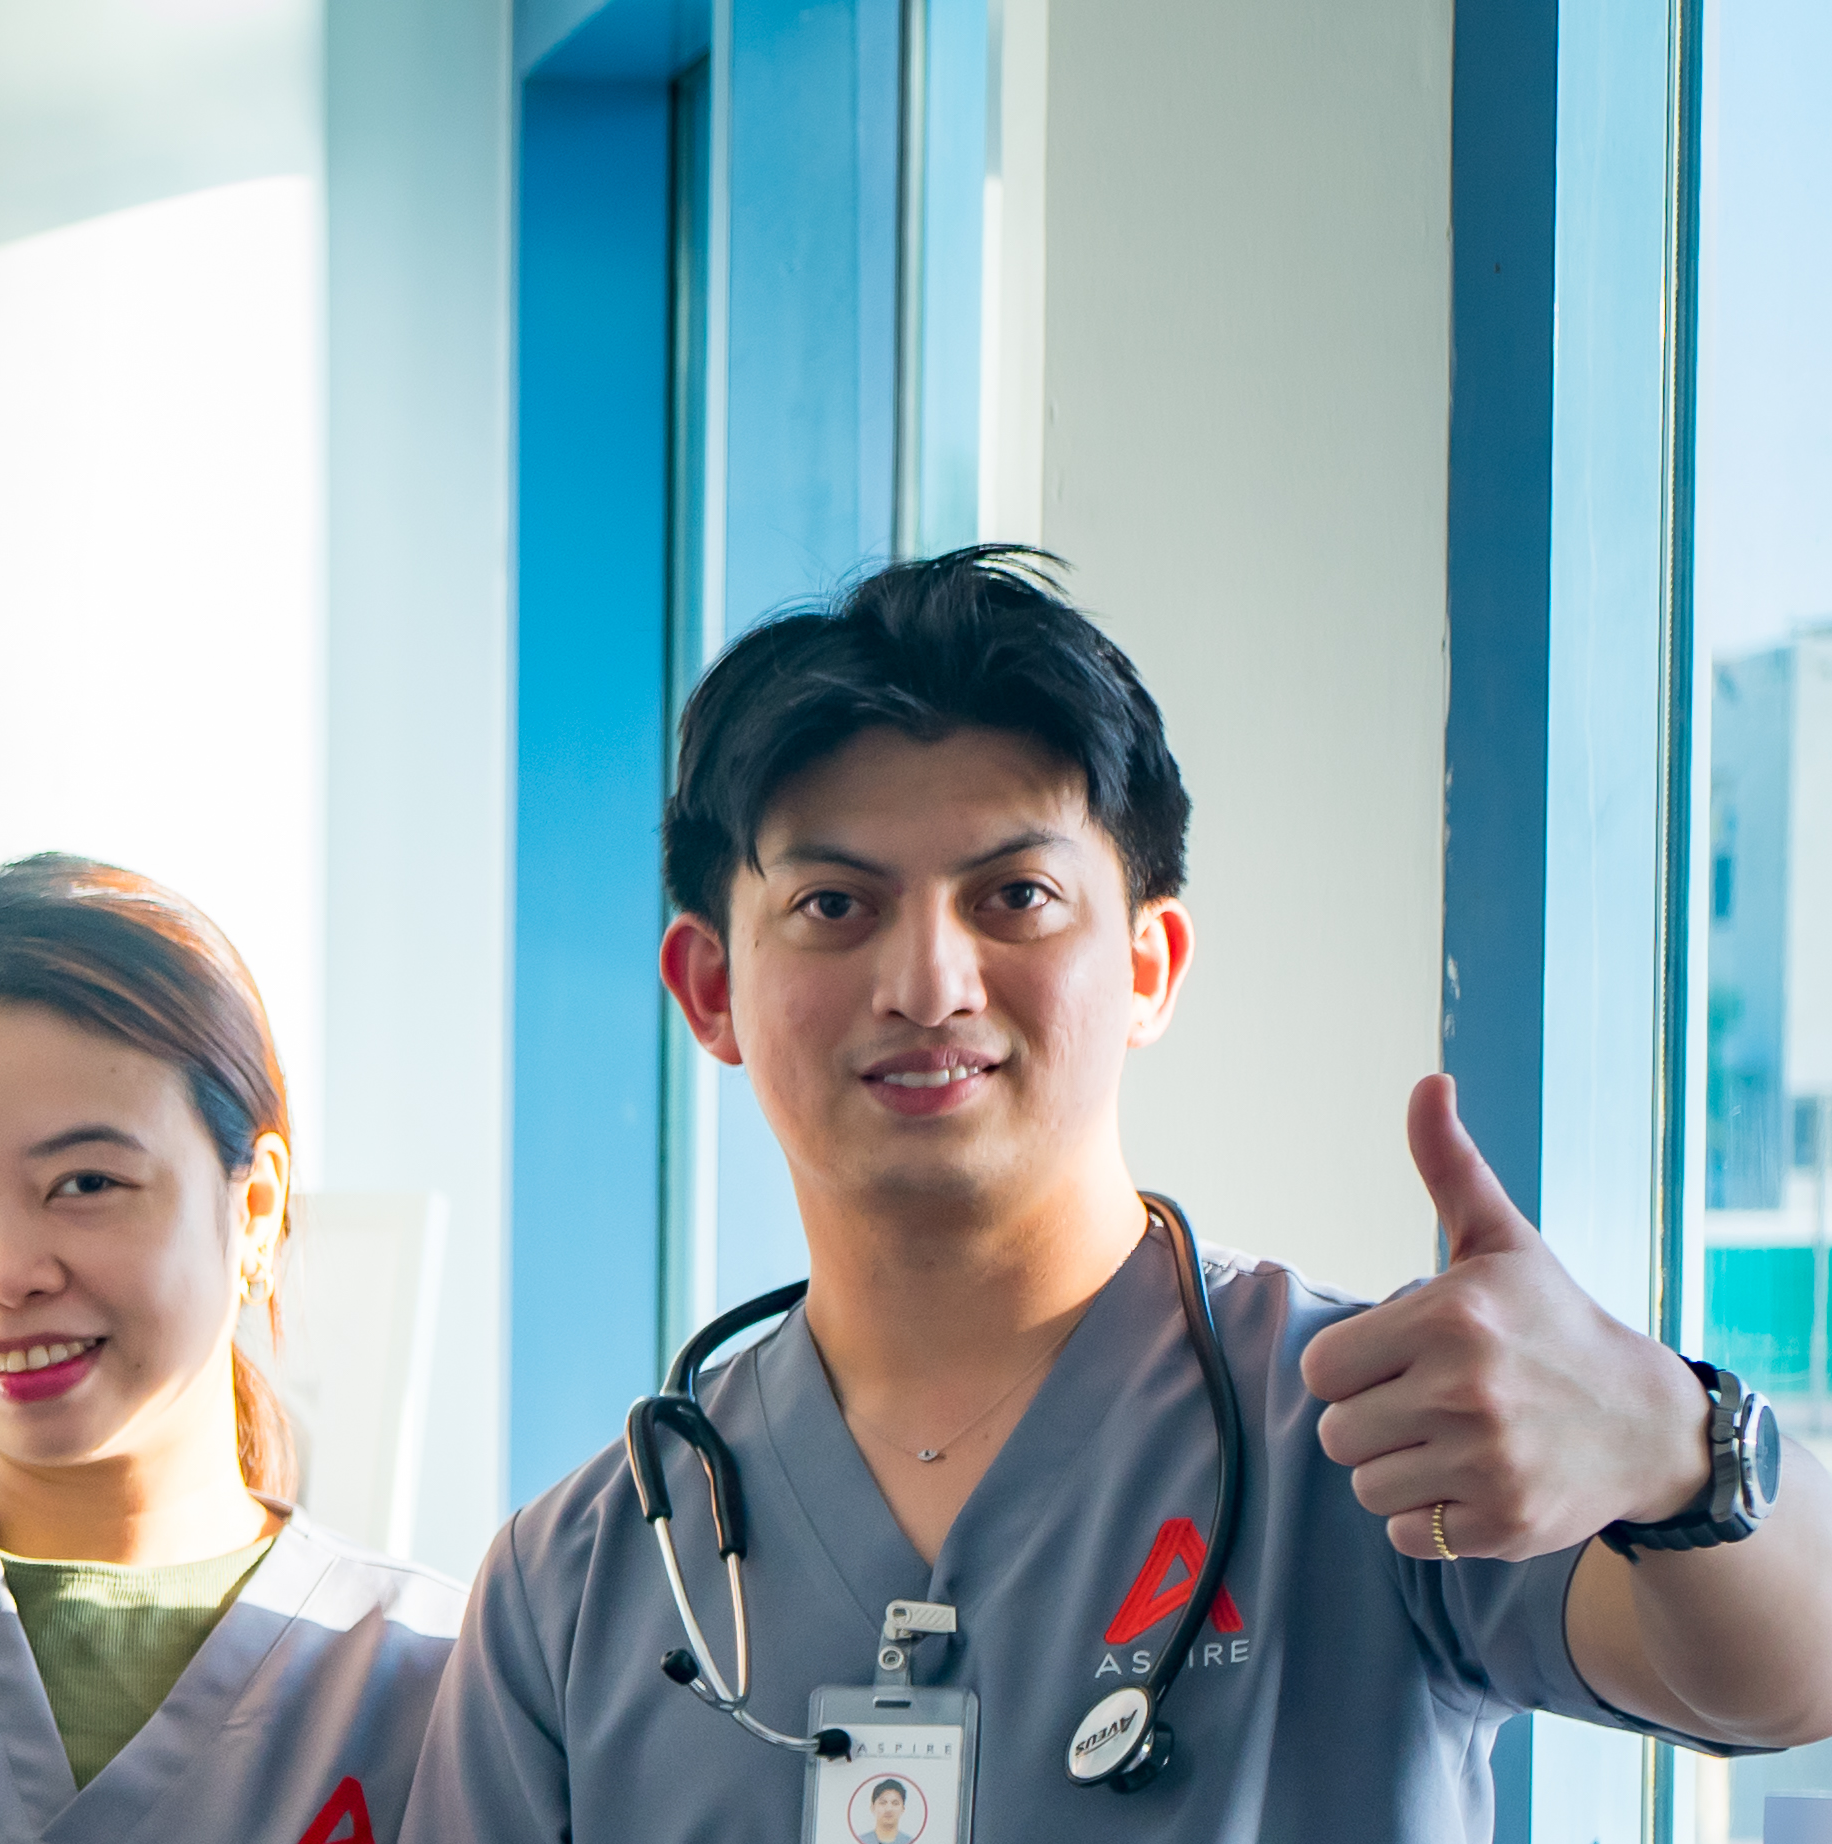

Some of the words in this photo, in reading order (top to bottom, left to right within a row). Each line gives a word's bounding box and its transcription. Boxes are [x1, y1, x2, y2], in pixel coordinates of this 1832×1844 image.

[1094, 1638, 1250, 1678] ASIRE
[856, 1742, 952, 1755] ASPIRE
[1075, 1709, 1138, 1757] AVEUS
